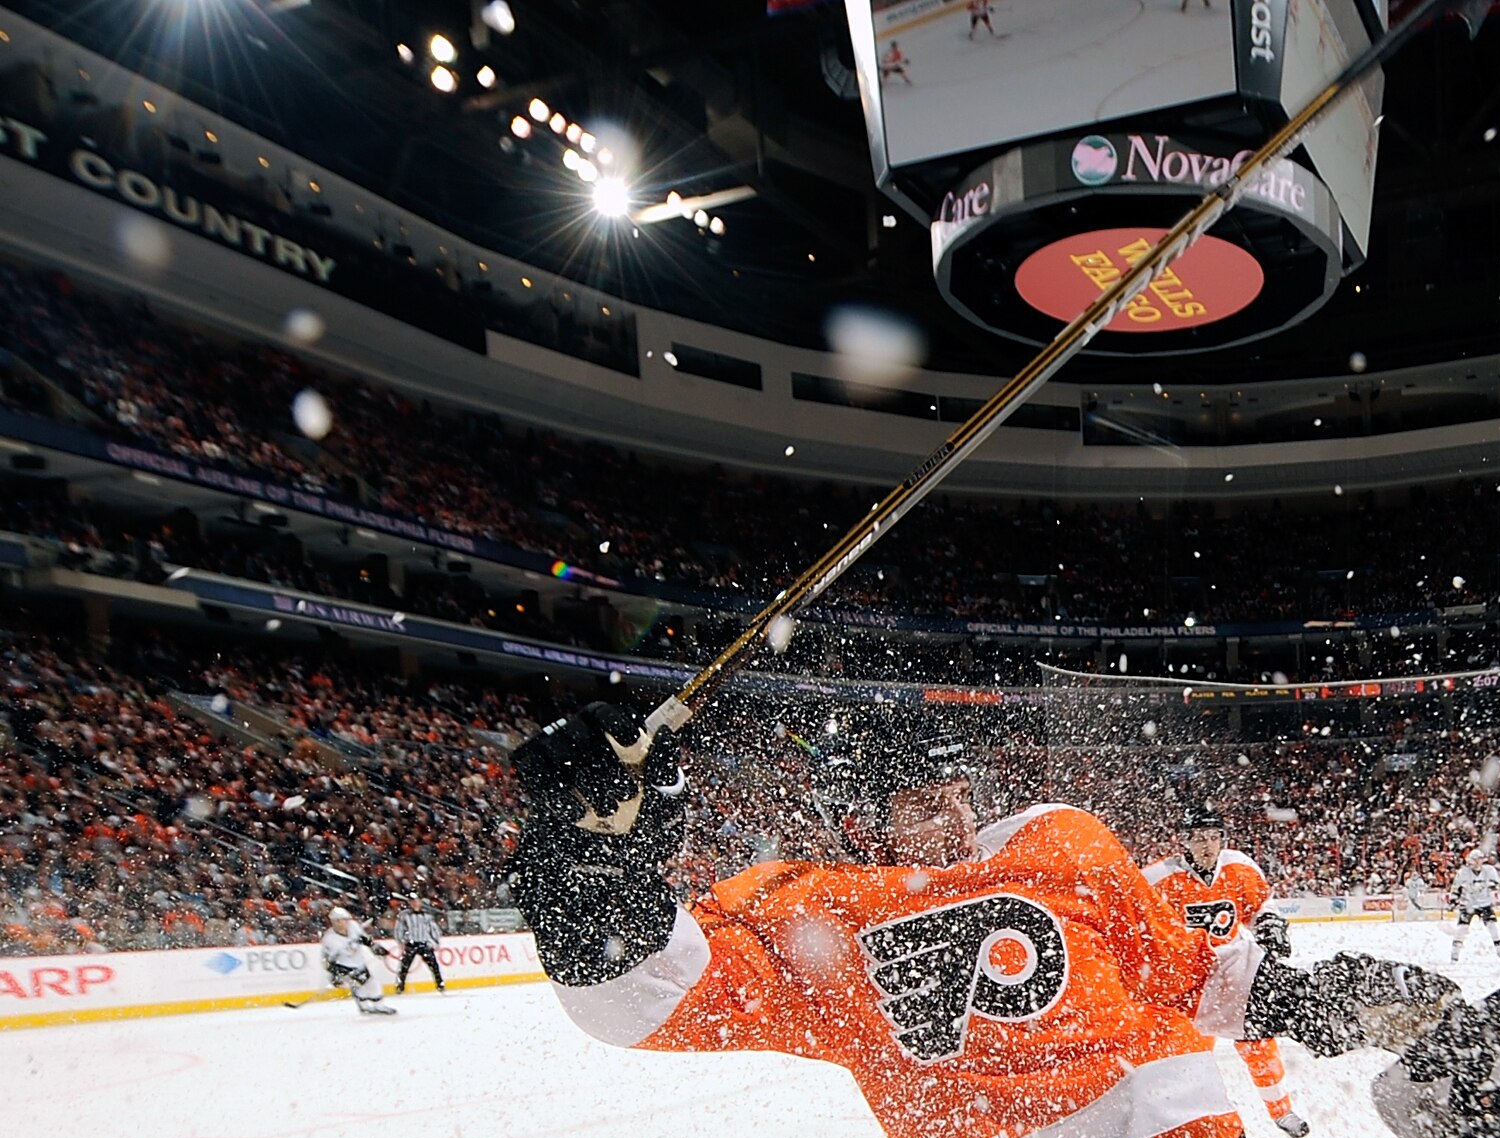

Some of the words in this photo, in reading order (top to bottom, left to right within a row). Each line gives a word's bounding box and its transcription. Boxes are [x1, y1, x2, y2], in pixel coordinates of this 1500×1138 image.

[68, 149, 337, 284] COUNTRY
[967, 621, 1014, 635] OFFICIAL
[1016, 623, 1058, 636] AIRLINE
[1059, 624, 1074, 636] OF
[1076, 625, 1099, 637] THE
[1100, 625, 1176, 637] PHILADELPHIA
[1177, 624, 1217, 637] FLYERS
[246, 949, 307, 973] PECO
